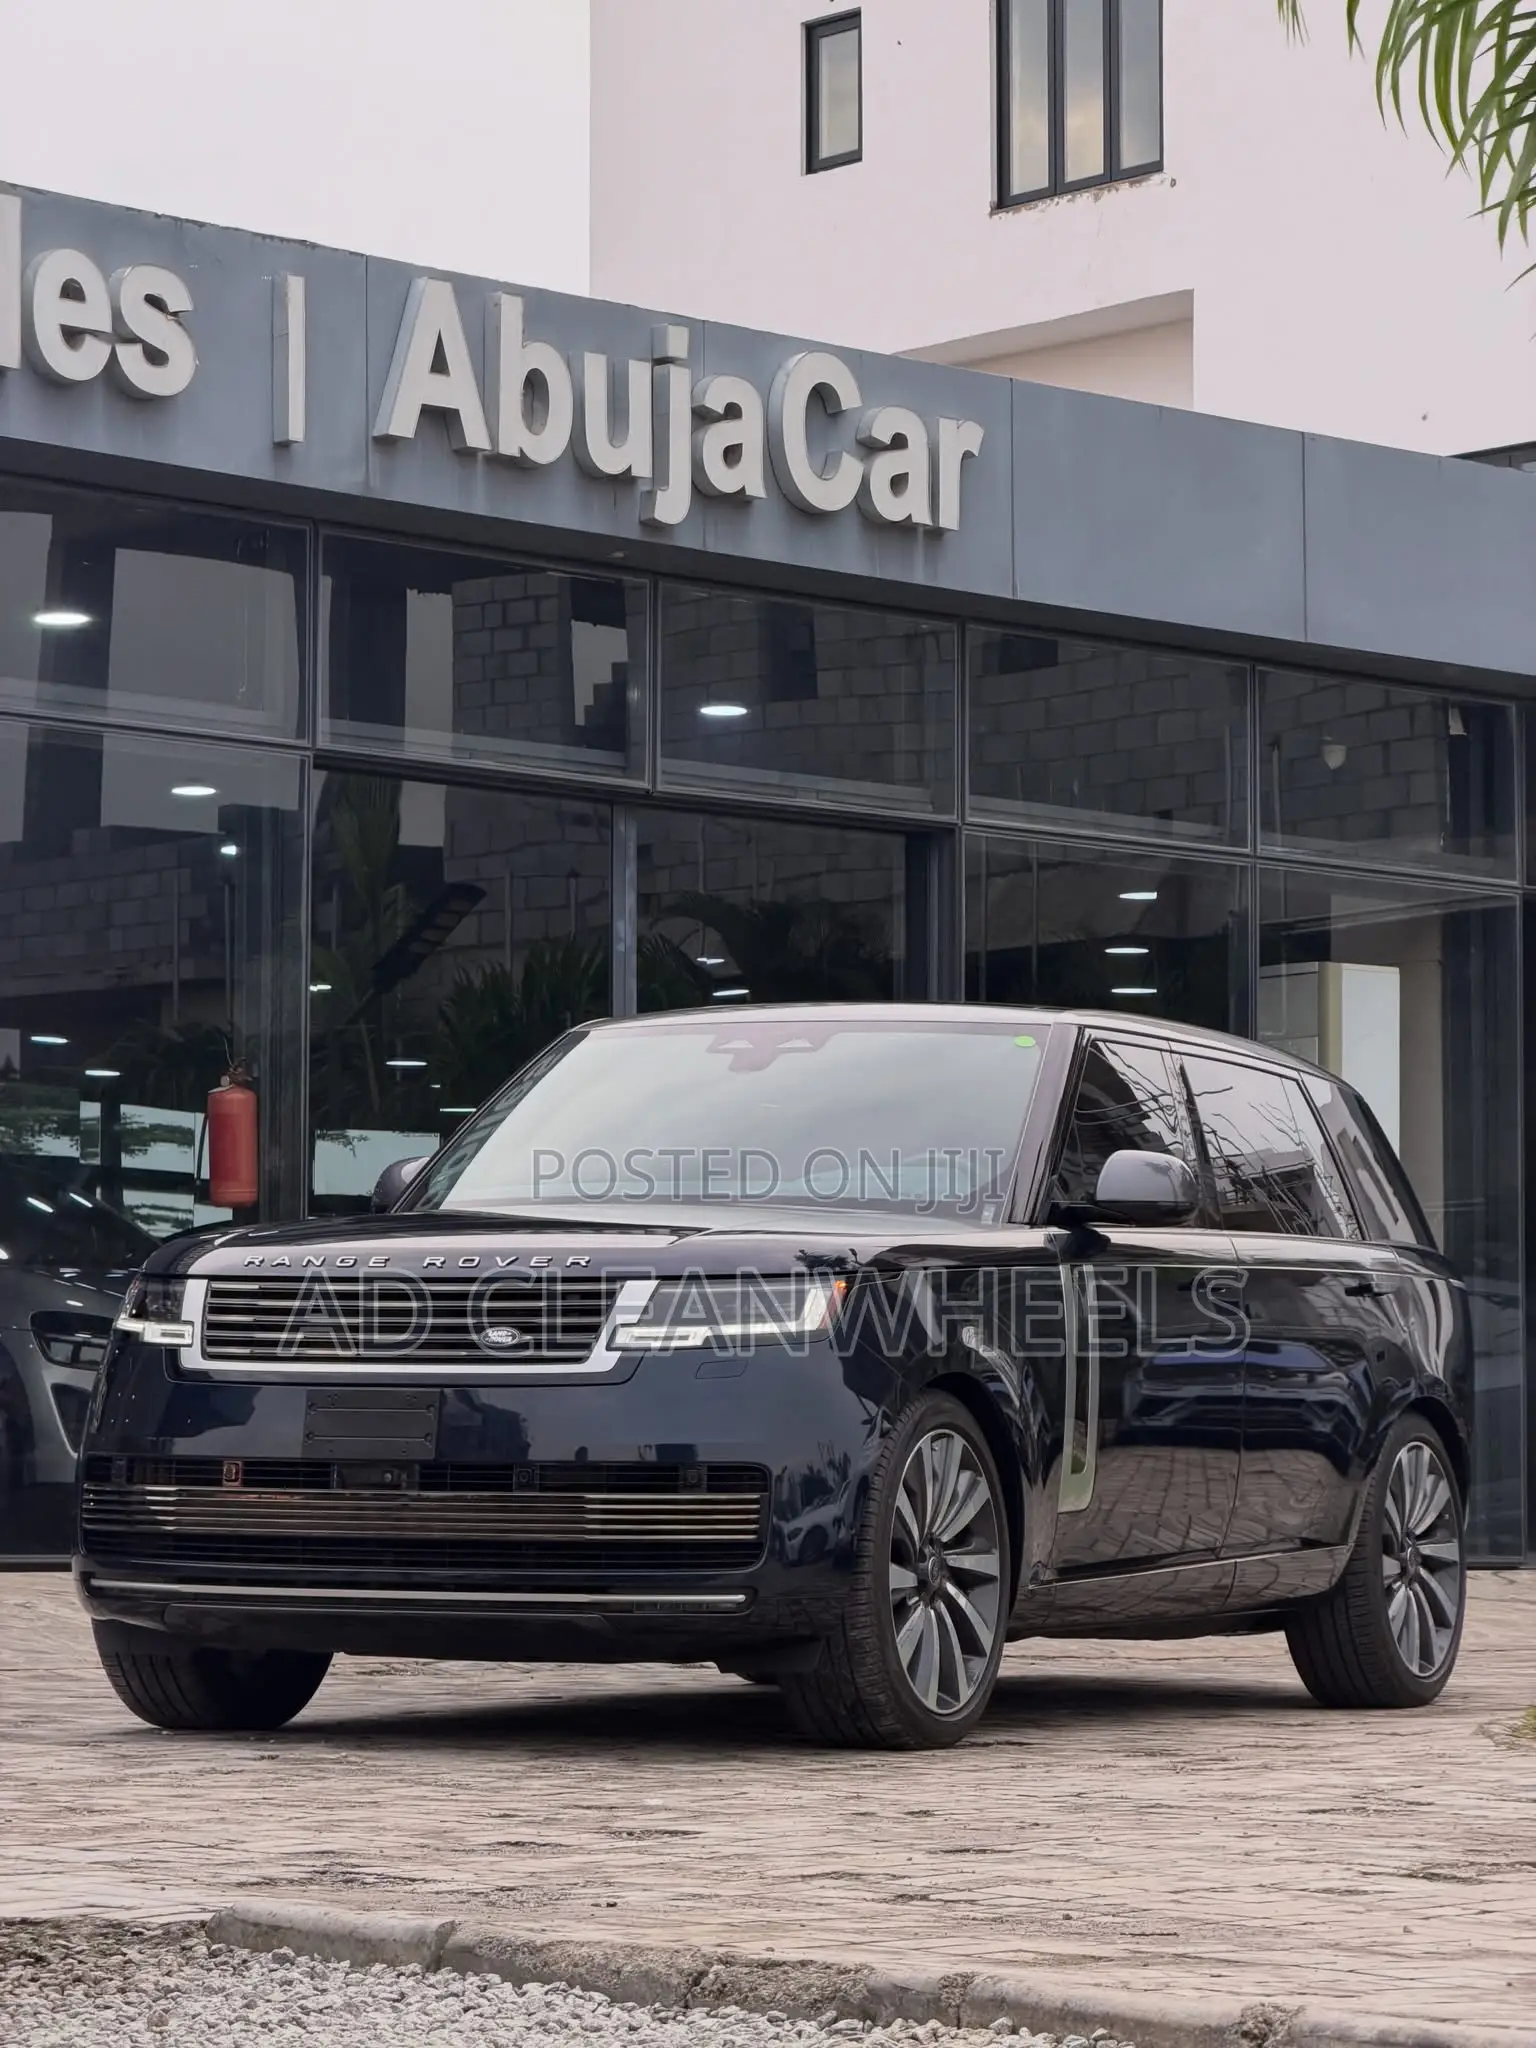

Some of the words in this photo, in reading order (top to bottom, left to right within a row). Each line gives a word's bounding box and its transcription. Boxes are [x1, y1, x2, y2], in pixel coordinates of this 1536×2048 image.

[372, 276, 985, 530] AbujaCar
[243, 1255, 390, 1270] RANGE
[422, 1255, 592, 1270] ROVER
